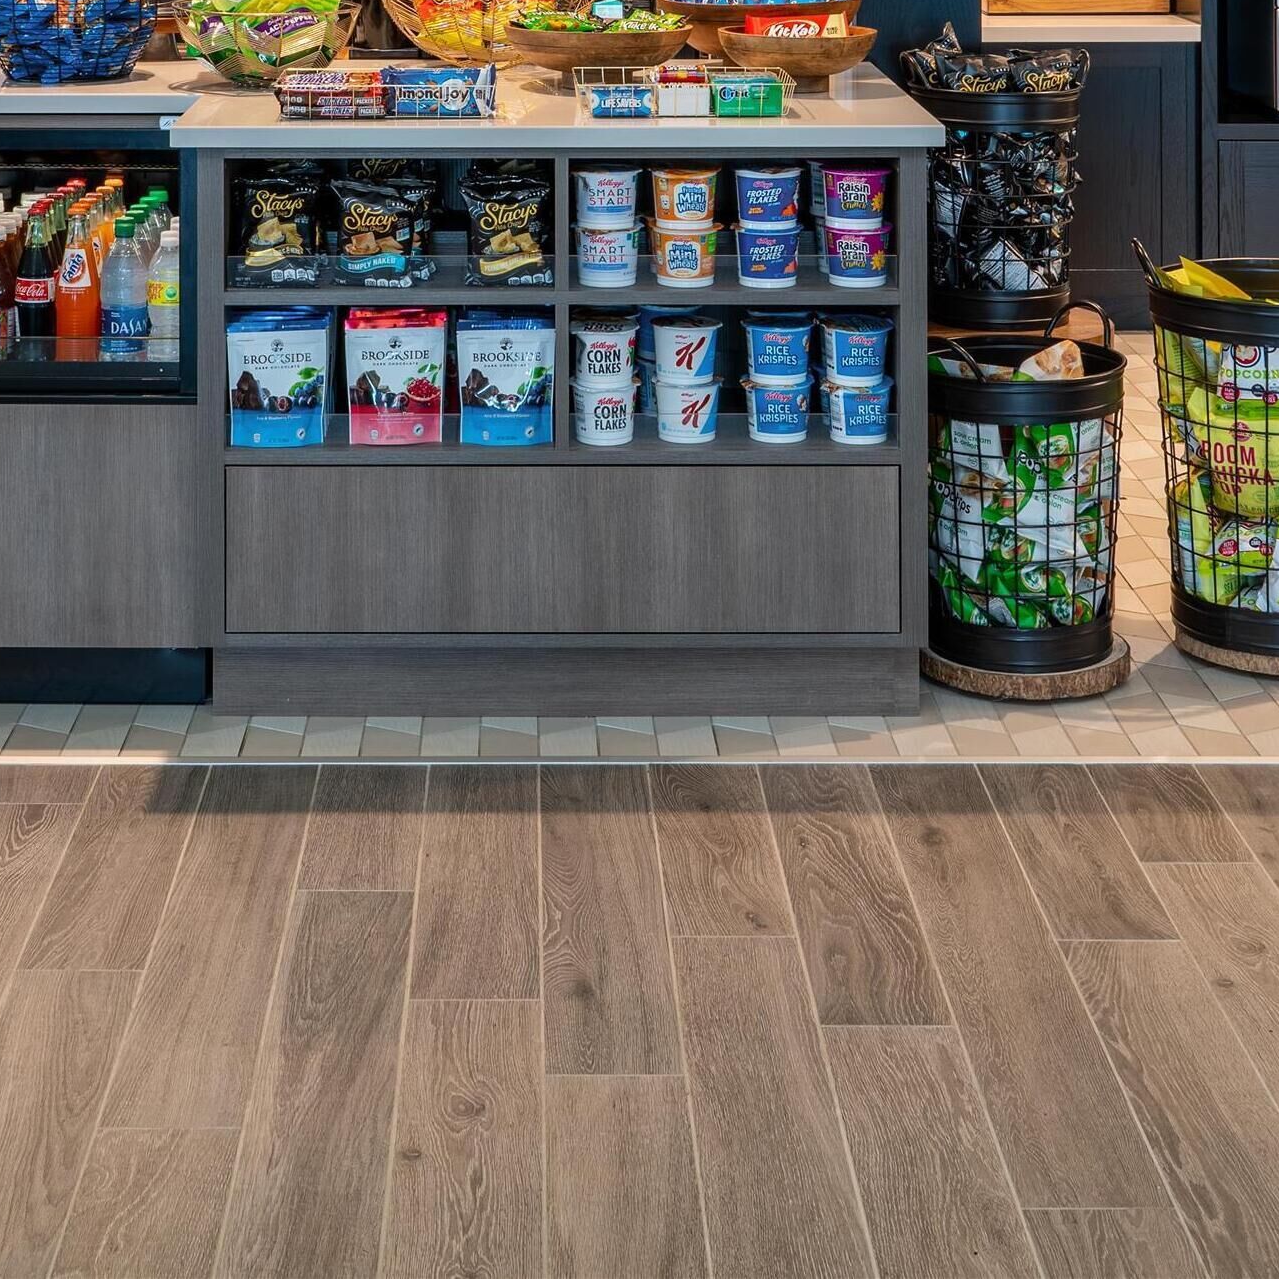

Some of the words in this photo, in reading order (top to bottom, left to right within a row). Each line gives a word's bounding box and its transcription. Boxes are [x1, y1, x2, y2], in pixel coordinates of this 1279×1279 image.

[960, 74, 1007, 93] Stacy's
[719, 86, 750, 101] Orbit
[601, 99, 617, 108] LIFE
[617, 98, 642, 108] SAVERS
[598, 178, 625, 188] Kellogg's
[838, 182, 870, 193] Raisin
[589, 187, 632, 197] SMART
[747, 188, 781, 198] FROSTED
[842, 192, 867, 202] Bran
[589, 197, 632, 205] START
[679, 192, 706, 204] Mini
[748, 195, 778, 204] FLAKES
[251, 190, 304, 218] Stacy's
[676, 202, 706, 213] Wheats
[344, 203, 398, 233] Stacy's
[480, 202, 538, 230] Stacy's
[582, 245, 626, 254] SMART
[749, 245, 785, 255] FROSTED
[838, 241, 868, 252] Raisin
[584, 254, 626, 263] START
[669, 250, 696, 261] Mini
[751, 253, 781, 261] FLAKES
[841, 251, 866, 261] Bran
[62, 253, 83, 282] Fanta
[348, 262, 371, 270] SIMPLY
[373, 257, 396, 266] NAKED
[668, 259, 698, 270] Wheats
[111, 318, 147, 338] DASAN
[763, 333, 791, 344] Kellogg's
[849, 335, 877, 345] Kellogg's
[590, 342, 617, 350] Kellogg's
[766, 346, 790, 355] RICE
[361, 350, 430, 361] BROOKSIDE
[472, 352, 541, 362] BROOKSIDE
[587, 349, 621, 363] CORN
[675, 336, 707, 370] K
[851, 348, 874, 357] RICE
[244, 353, 312, 365] BROOKSIDE
[758, 355, 798, 365] KRISPIES
[842, 357, 880, 366] KRISPIES
[588, 363, 621, 374] FLAKES
[764, 391, 793, 401] Kellogg's
[594, 405, 627, 419] CORN
[681, 394, 711, 428] K
[767, 404, 791, 413] RICE
[858, 405, 881, 414] RICE
[759, 414, 799, 423] KRISPIES
[849, 415, 887, 426] KRISPIES
[595, 419, 627, 430] FLAKES
[1081, 421, 1099, 435] onion
[960, 440, 979, 450] onion
[968, 435, 991, 445] cream
[1202, 440, 1256, 466] BOOM
